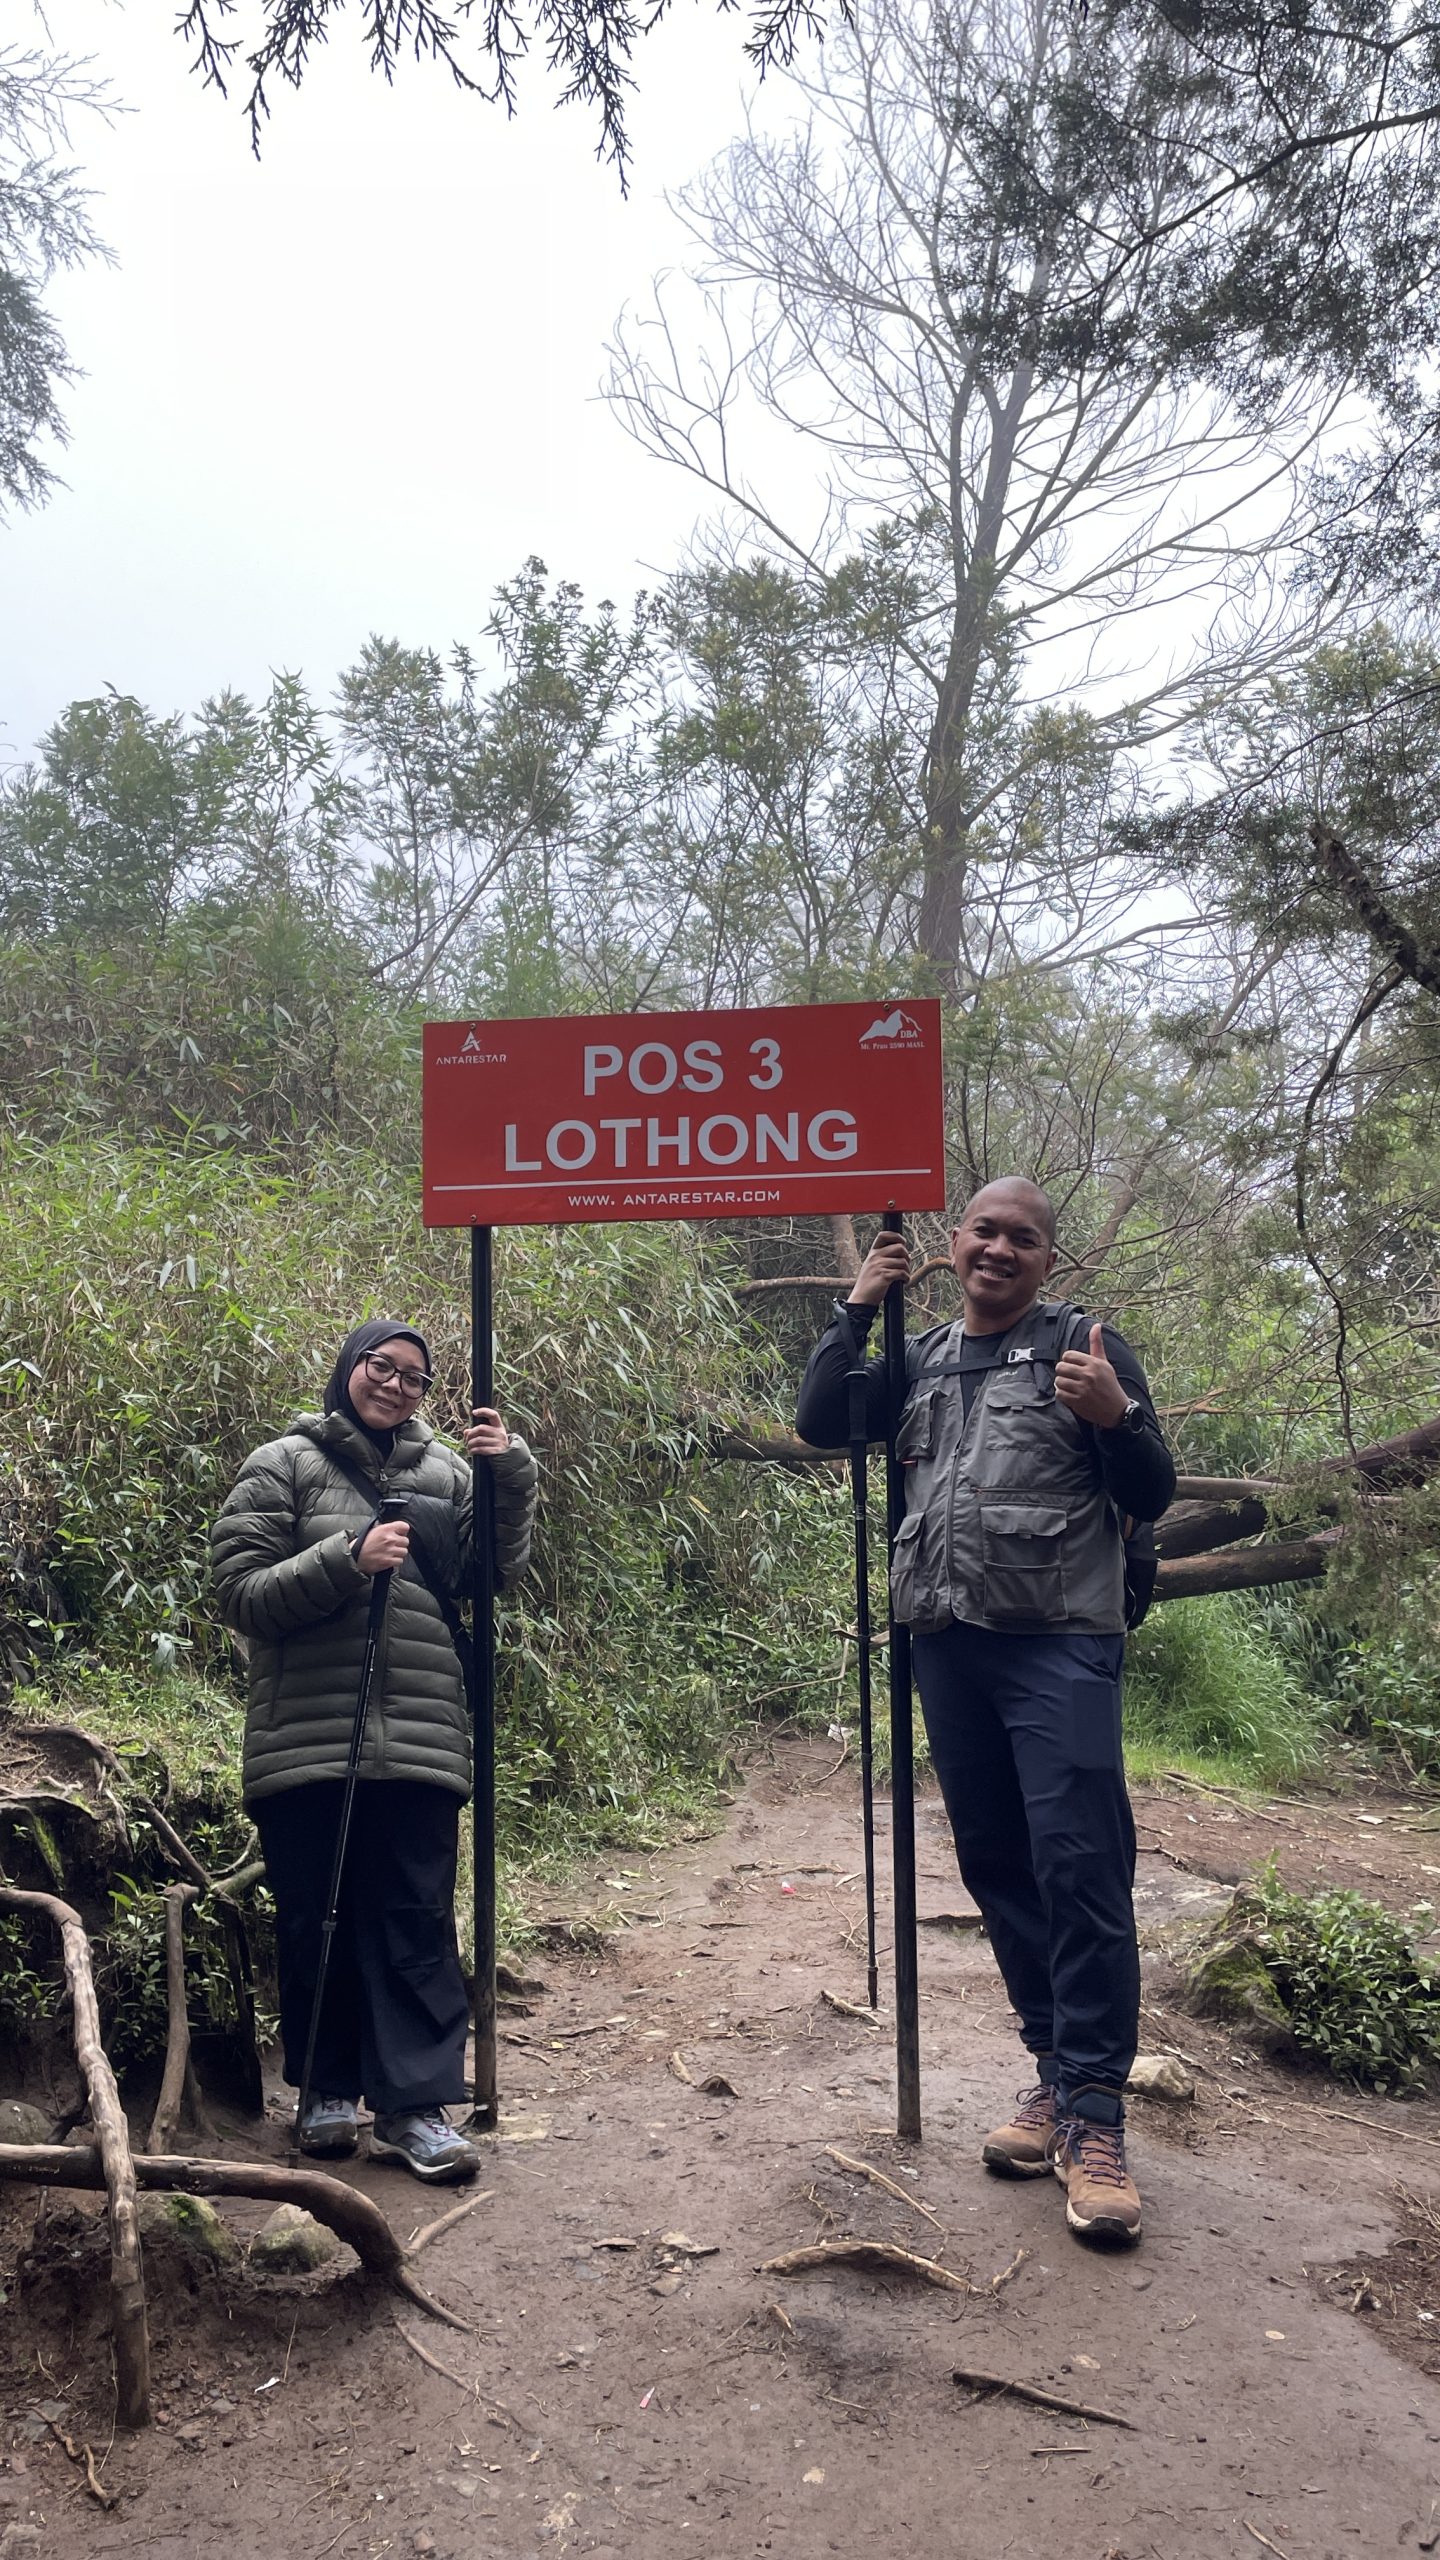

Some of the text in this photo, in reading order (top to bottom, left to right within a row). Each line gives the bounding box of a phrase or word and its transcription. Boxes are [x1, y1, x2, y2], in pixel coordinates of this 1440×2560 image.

[900, 1030, 918, 1039] DBA
[906, 1041, 925, 1049] MASL
[435, 1053, 507, 1065] ANTARESTAR
[583, 1038, 784, 1096] POS 3
[504, 1109, 859, 1172] LOTHONG
[622, 1190, 780, 1206] ANTARESTAR.COM
